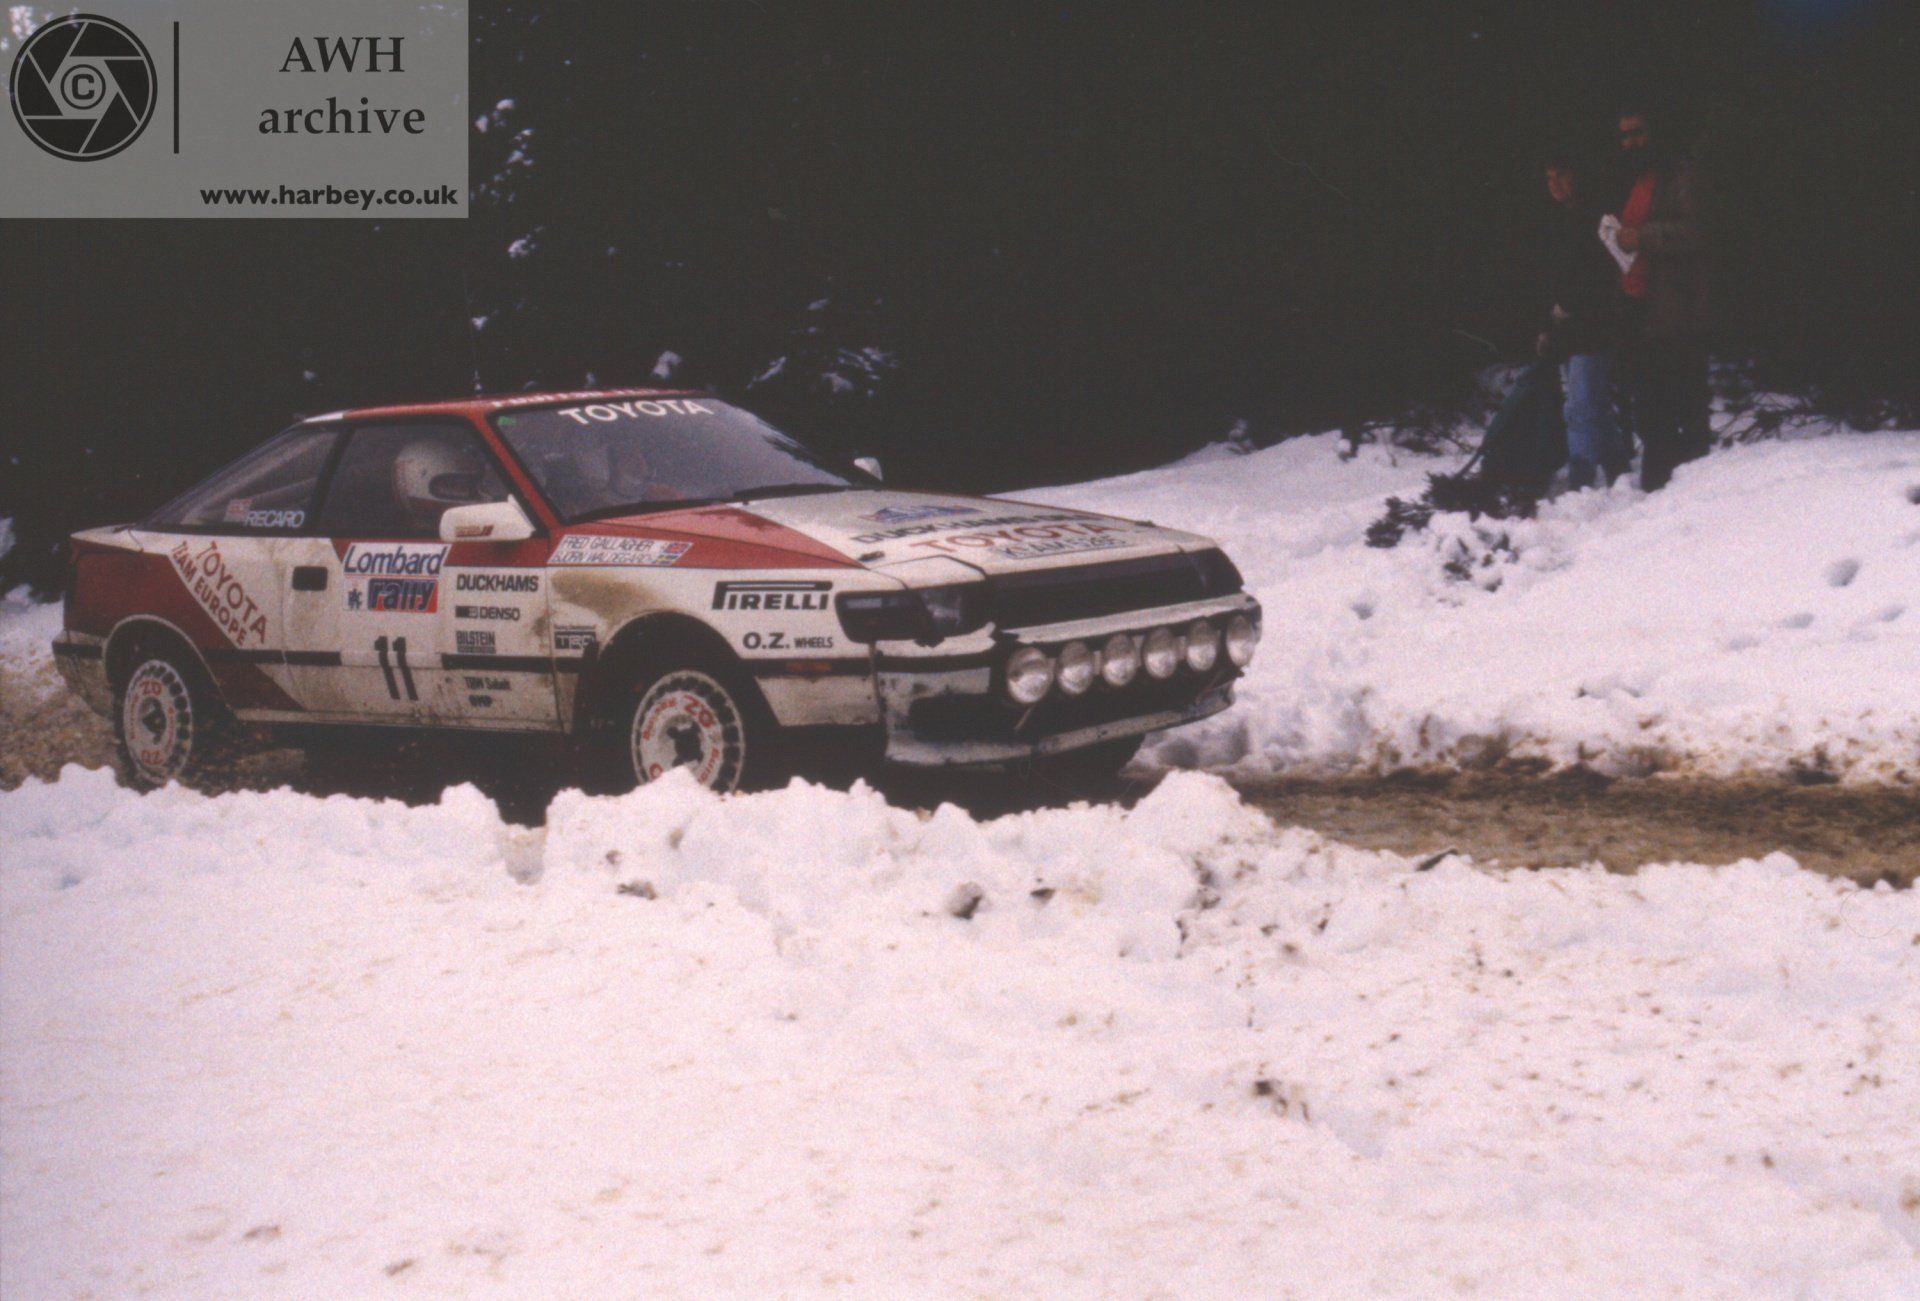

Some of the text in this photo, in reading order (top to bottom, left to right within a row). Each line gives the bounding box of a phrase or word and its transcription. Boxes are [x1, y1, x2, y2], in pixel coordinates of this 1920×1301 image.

[557, 399, 714, 425] TOYOTA
[244, 510, 305, 529] RECARO
[910, 523, 1130, 552] TOYOTA
[172, 541, 198, 583] TEAM
[344, 545, 448, 575] Lombard
[196, 541, 268, 645] TOYOTA
[367, 580, 436, 611] rally
[456, 574, 540, 592] DUCKHAMS
[711, 580, 833, 611] PIRELLI
[194, 576, 247, 647] EUROPE
[479, 606, 521, 622] DENSO
[456, 631, 496, 646] BILSTEIN
[742, 631, 834, 650] O.Z. WHEELS
[374, 636, 419, 701] 11
